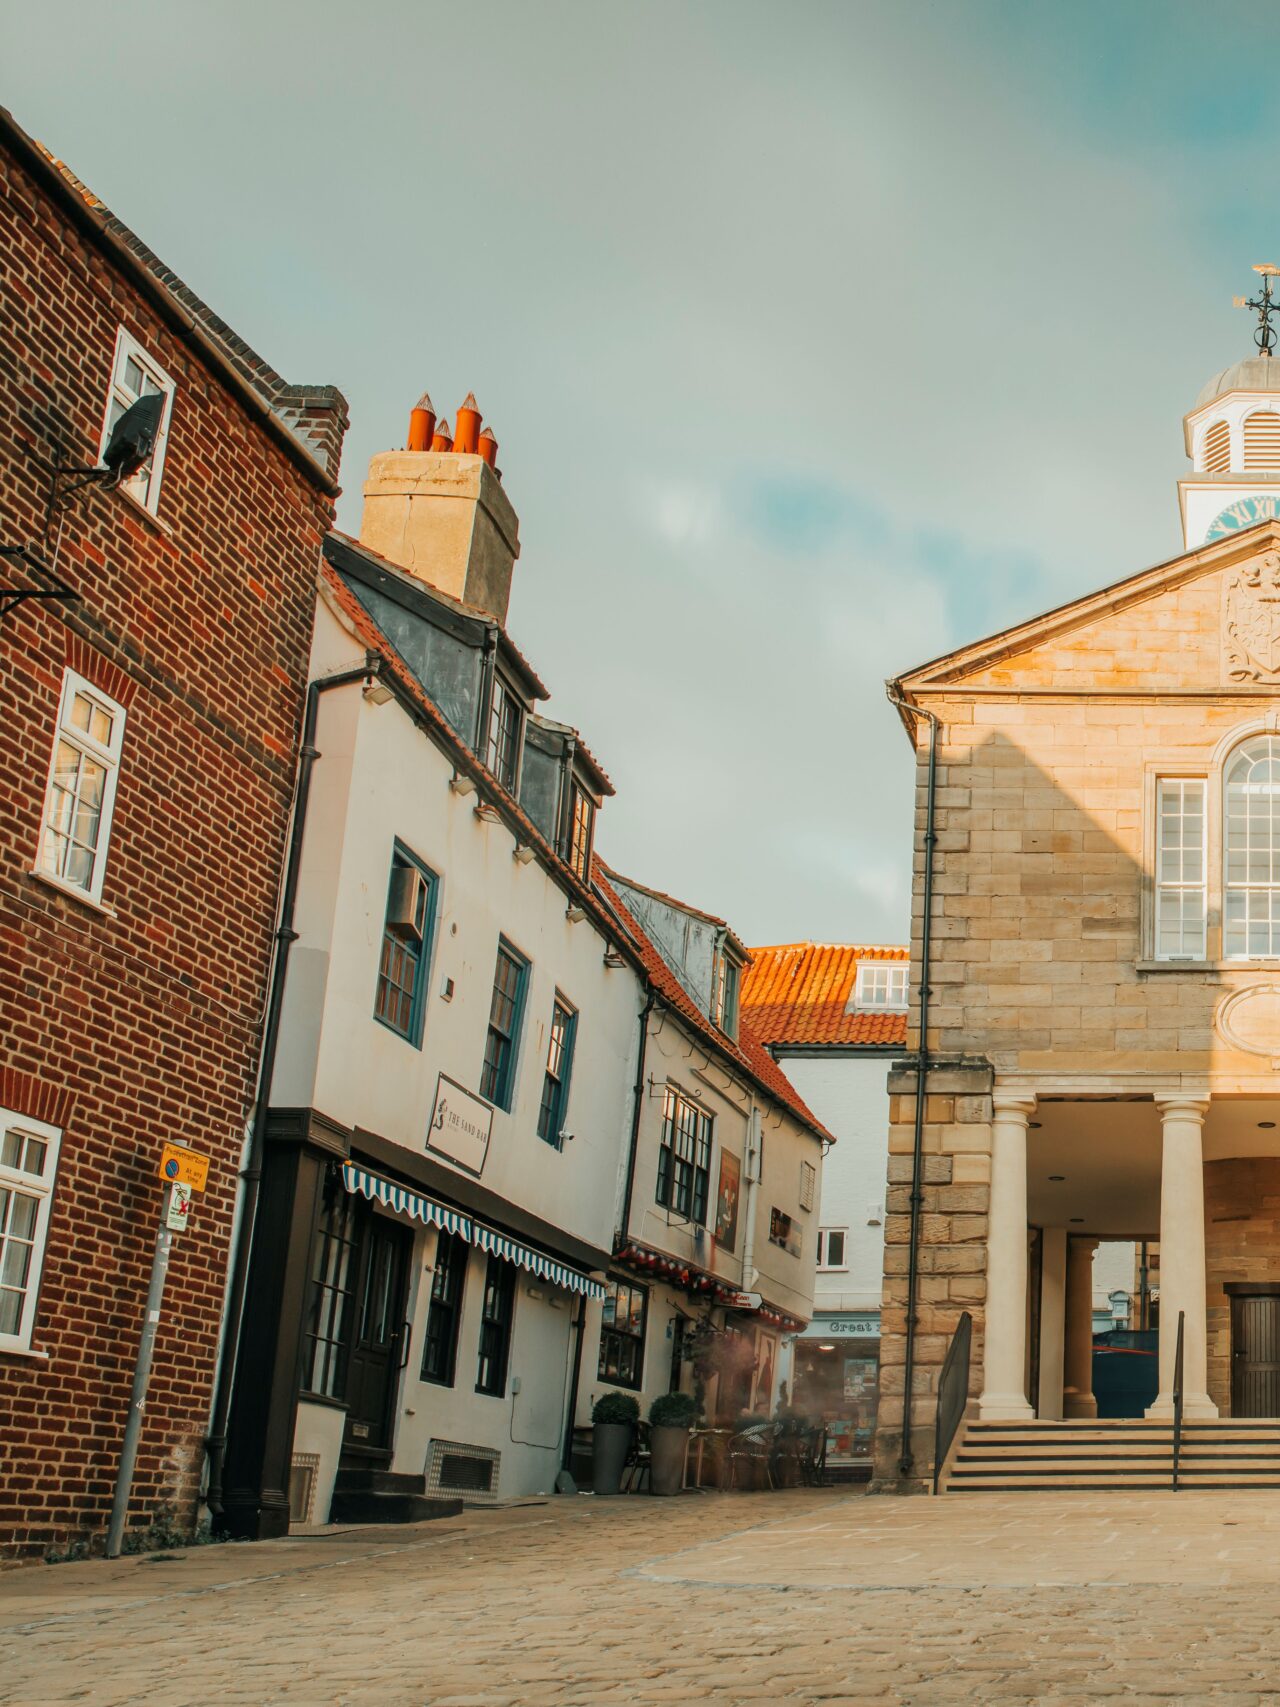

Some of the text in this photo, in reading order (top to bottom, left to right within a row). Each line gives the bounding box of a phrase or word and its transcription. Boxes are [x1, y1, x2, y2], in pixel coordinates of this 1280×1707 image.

[1253, 499, 1276, 519] XII
[448, 1111, 460, 1126] THE
[461, 1119, 476, 1136] SAND
[476, 1127, 487, 1144] BAR
[829, 1321, 872, 1333] Great
